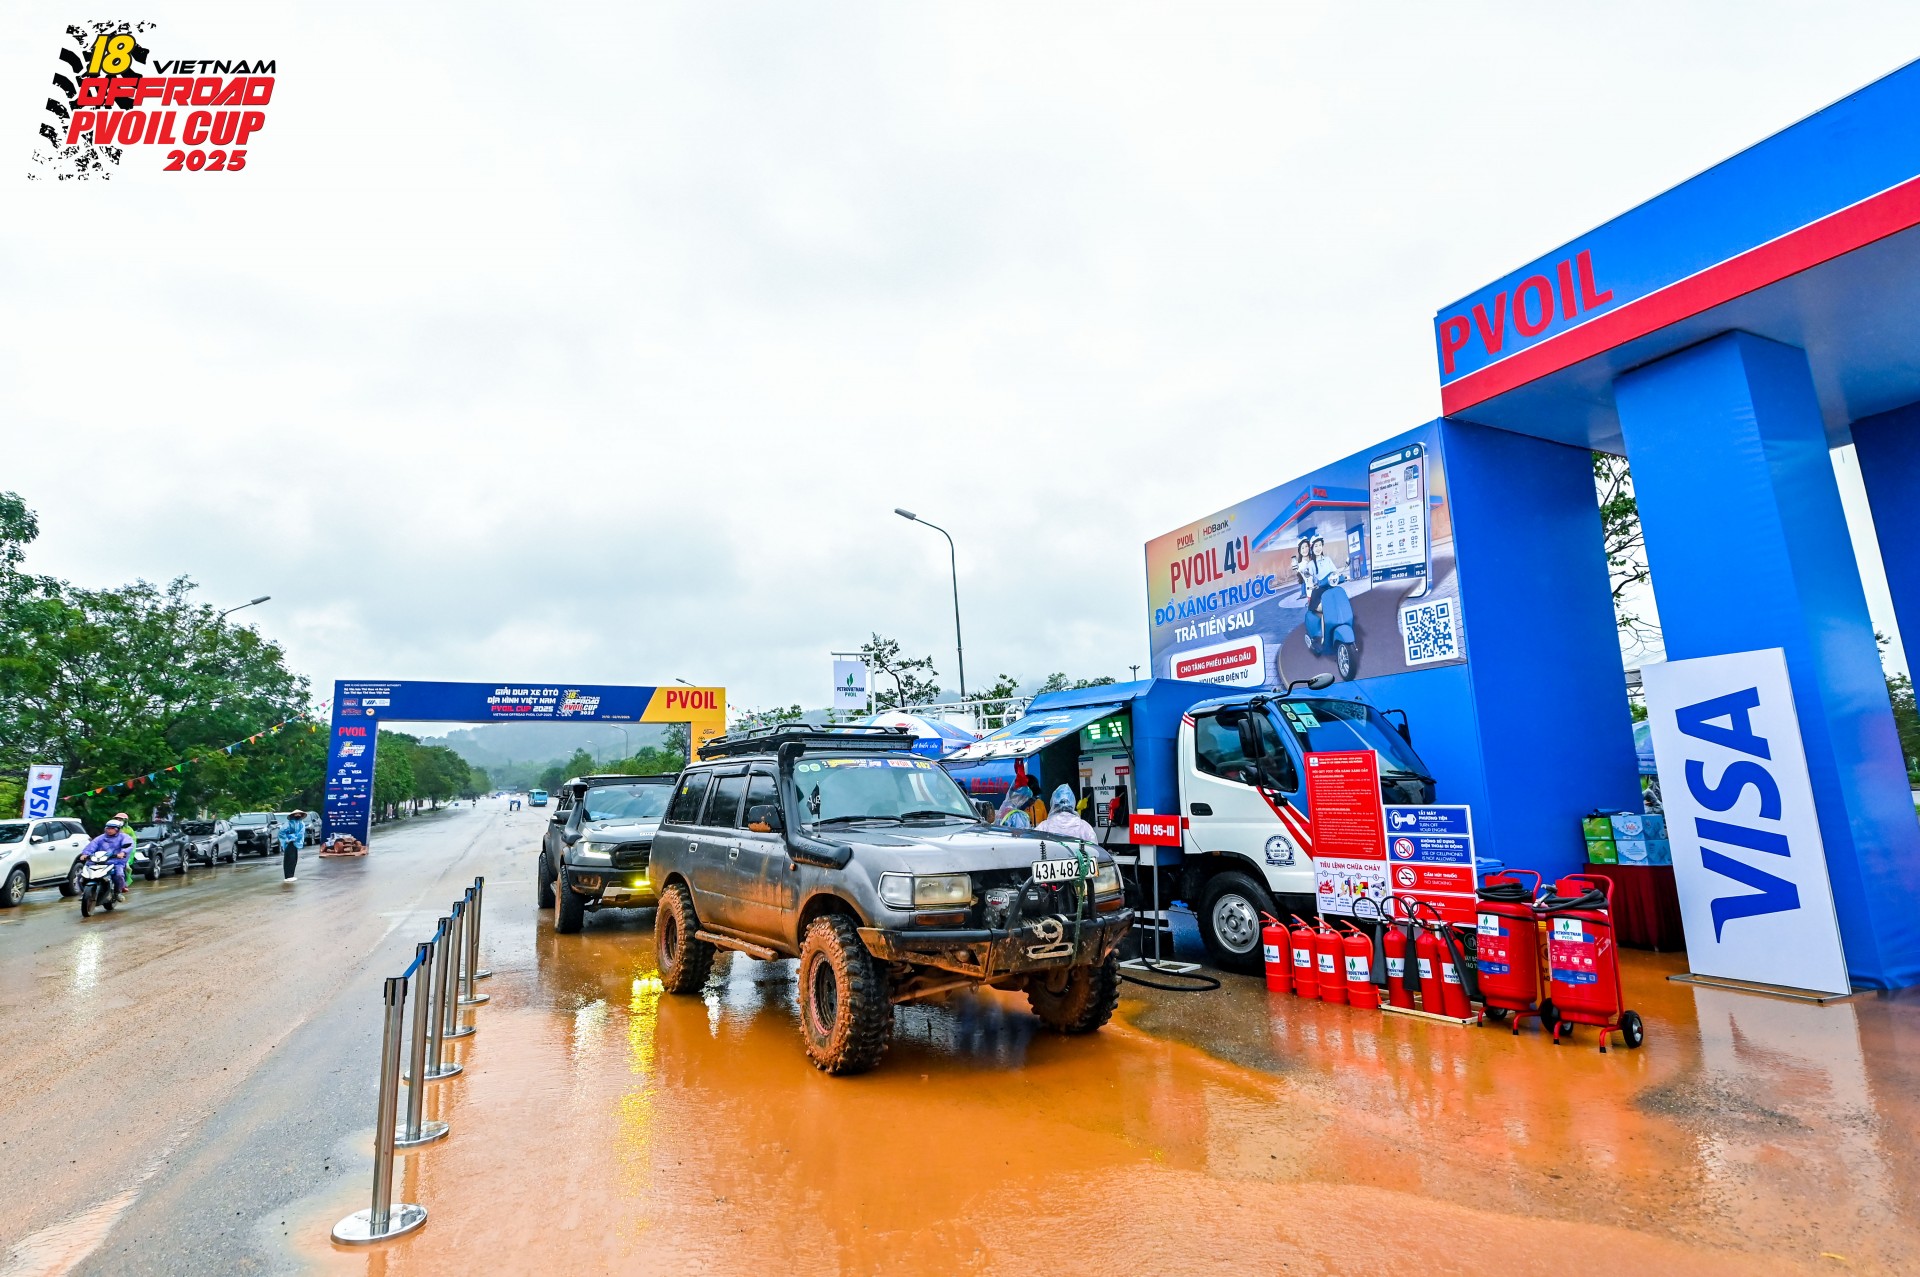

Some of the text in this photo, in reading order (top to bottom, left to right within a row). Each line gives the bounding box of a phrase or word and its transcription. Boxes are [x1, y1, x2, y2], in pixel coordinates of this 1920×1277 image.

[1439, 248, 1614, 375] PVOIL
[1202, 519, 1230, 537] HDBank
[1176, 532, 1195, 548] PVOIL
[1170, 547, 1223, 594] PVOIL
[1154, 574, 1277, 627] ĐỔ XĂNG TRƯỚC
[1174, 609, 1254, 644] TRẢ TIỀN SAU
[1180, 664, 1192, 674] CHO
[1225, 671, 1240, 684] ĐIỆN
[495, 687, 511, 696] GIẢI
[567, 691, 577, 699] 18
[520, 696, 538, 705] VIỆT
[563, 704, 583, 712] PVOIL
[666, 690, 718, 710] PVOIL
[515, 705, 532, 713] CUP
[532, 705, 554, 713] 2025
[338, 726, 367, 737] PVOIL
[970, 777, 1010, 793] Mobile
[29, 785, 53, 819] ISA
[1675, 686, 1801, 944] VISA
[1133, 823, 1175, 837] RON 95-III
[1035, 859, 1096, 880] 43A-4820
[1319, 861, 1381, 872] TIÊU LỆNH CHỮA CHÁY
